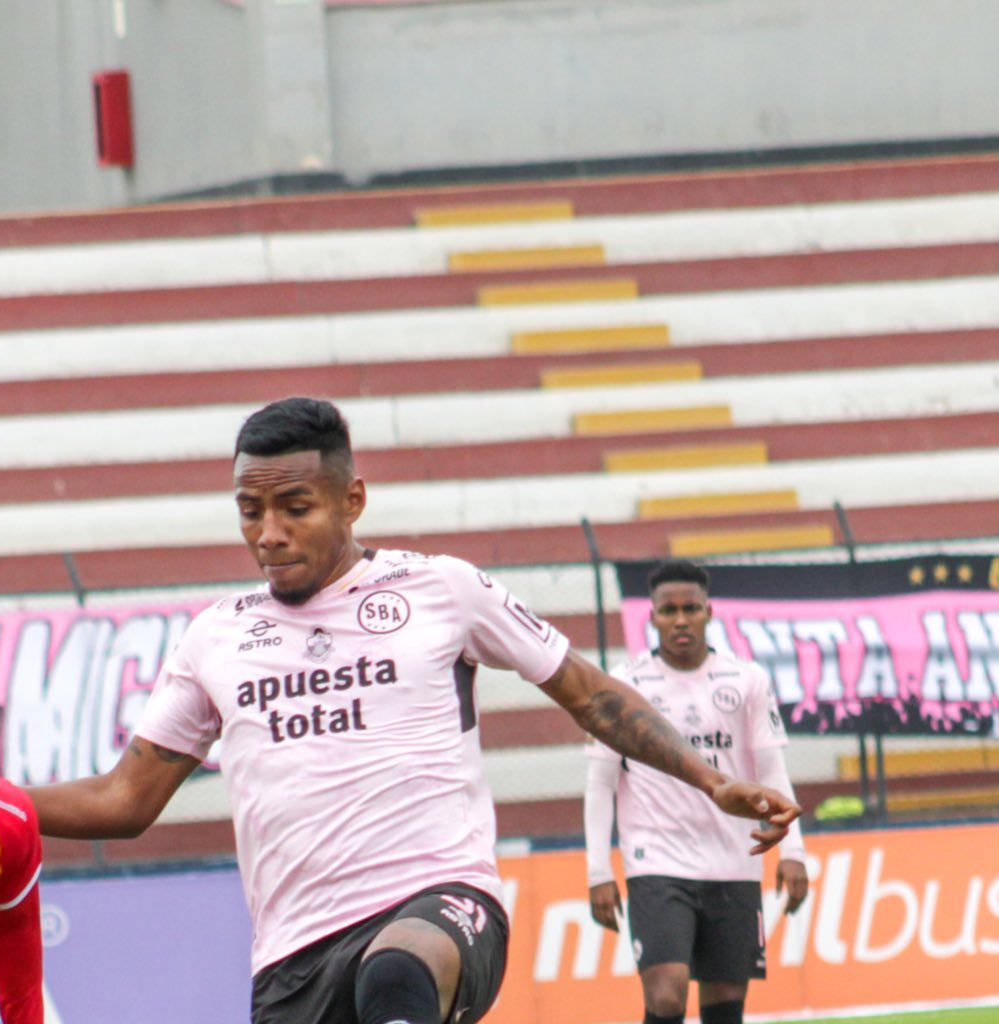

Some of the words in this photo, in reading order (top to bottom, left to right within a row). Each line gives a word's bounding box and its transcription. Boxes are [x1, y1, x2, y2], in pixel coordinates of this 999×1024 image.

[364, 602, 402, 623] SBA
[237, 635, 283, 653] ASTRO
[236, 655, 399, 713] apuesta
[269, 697, 367, 744] total
[690, 730, 733, 749] esta
